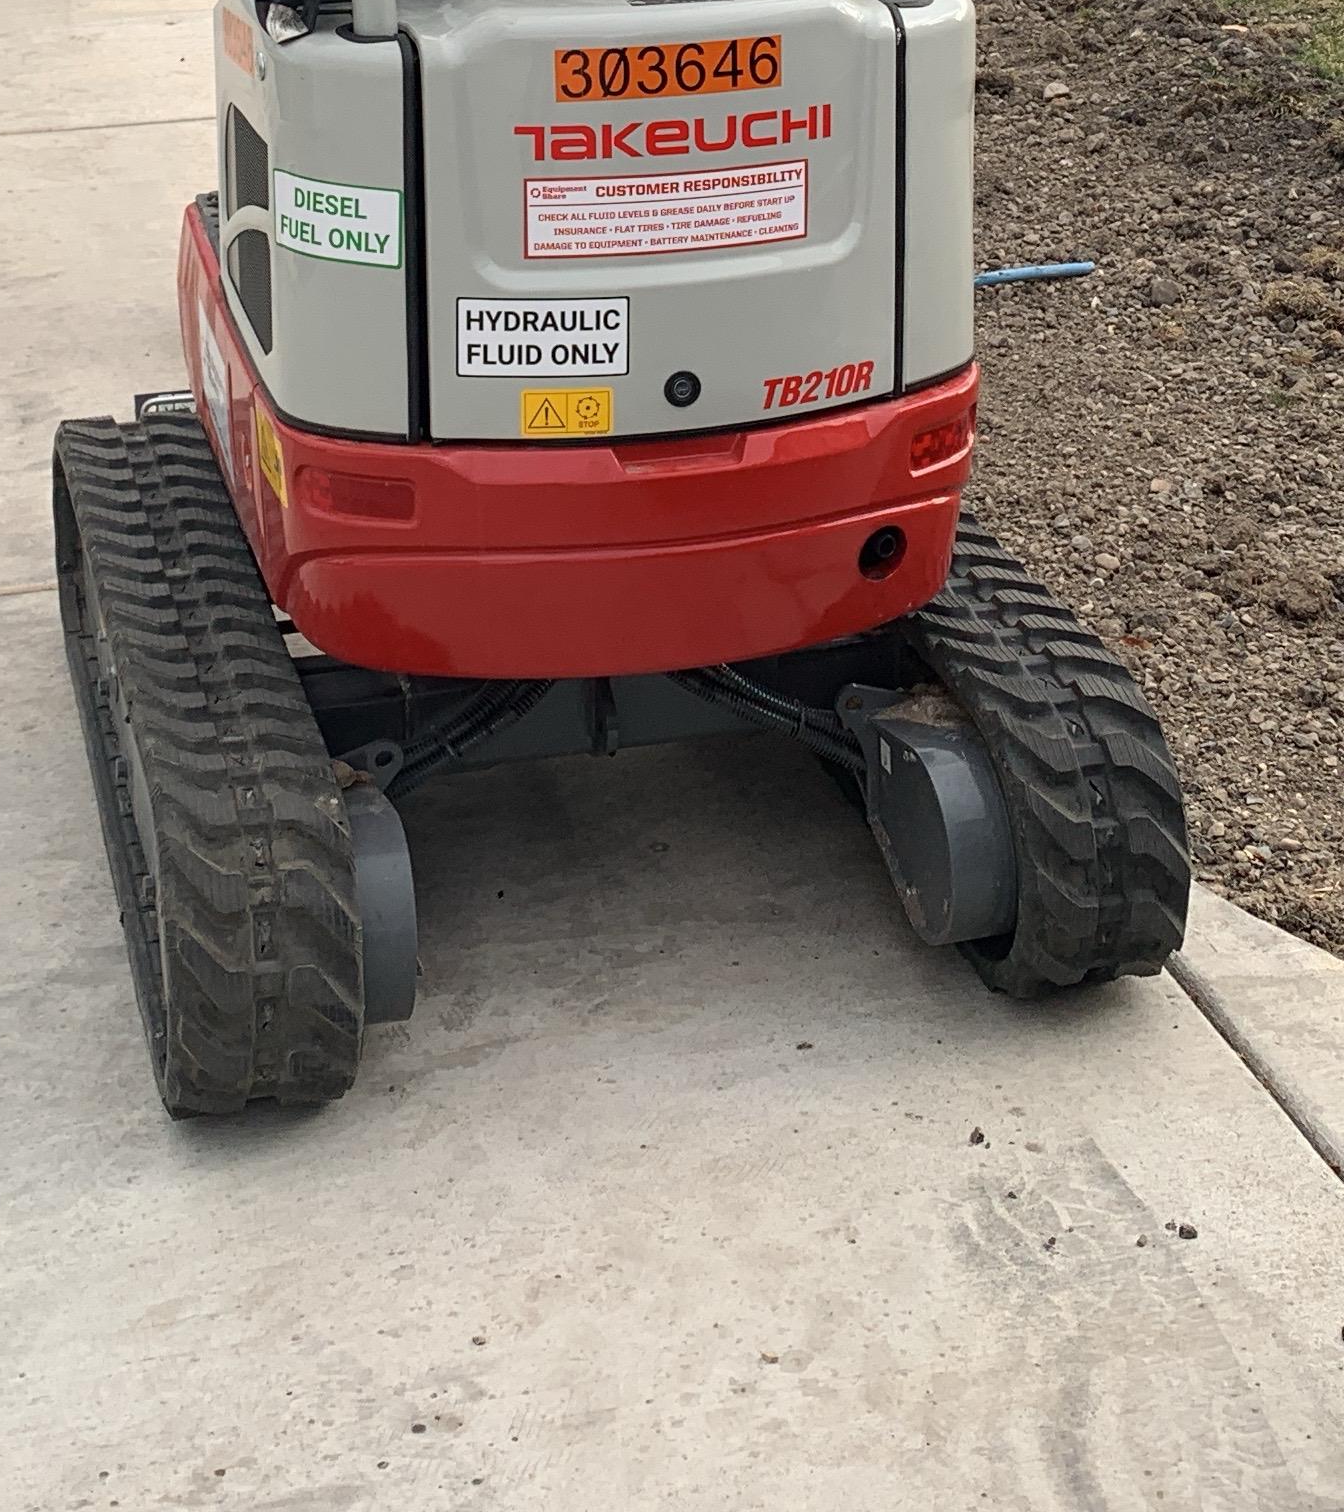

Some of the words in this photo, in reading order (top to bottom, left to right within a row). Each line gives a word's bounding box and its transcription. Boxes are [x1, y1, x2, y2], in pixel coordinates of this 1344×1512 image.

[560, 37, 779, 98] 303646
[514, 103, 832, 161] TAKEUCHI
[595, 181, 680, 198] CUSTOMER
[683, 168, 803, 192] RESPONSIBILITY
[294, 187, 368, 220] DIESEL
[538, 213, 568, 222] CHECK
[570, 212, 587, 221] ALL
[588, 211, 616, 220] FLUID
[617, 209, 650, 219] LEVELS
[660, 206, 695, 217] GREASE
[696, 203, 722, 214] DAILY
[723, 200, 755, 211] BEFORE
[756, 196, 783, 208] START
[784, 194, 796, 204] UP
[280, 214, 322, 246] FUEL
[328, 228, 391, 254] ONLY
[533, 242, 572, 251] DAMAGE
[575, 241, 587, 250] TO
[588, 239, 643, 249] EQUIPMENT
[650, 235, 689, 246] BATTERY
[690, 229, 753, 243] MAINTENANCE
[758, 222, 799, 236] CLEANING
[553, 226, 607, 236] INSURANCE
[614, 224, 635, 234] FLAT
[637, 223, 665, 233] TIRES
[671, 220, 692, 230] TIRE
[694, 216, 731, 228] DAMAGE
[736, 211, 782, 224] REFUELING
[465, 309, 621, 332] HYDRAULIC
[466, 343, 542, 366] FLUID
[550, 342, 620, 366] ONLY
[762, 359, 875, 411] TB210R
[578, 420, 600, 429] STOP
